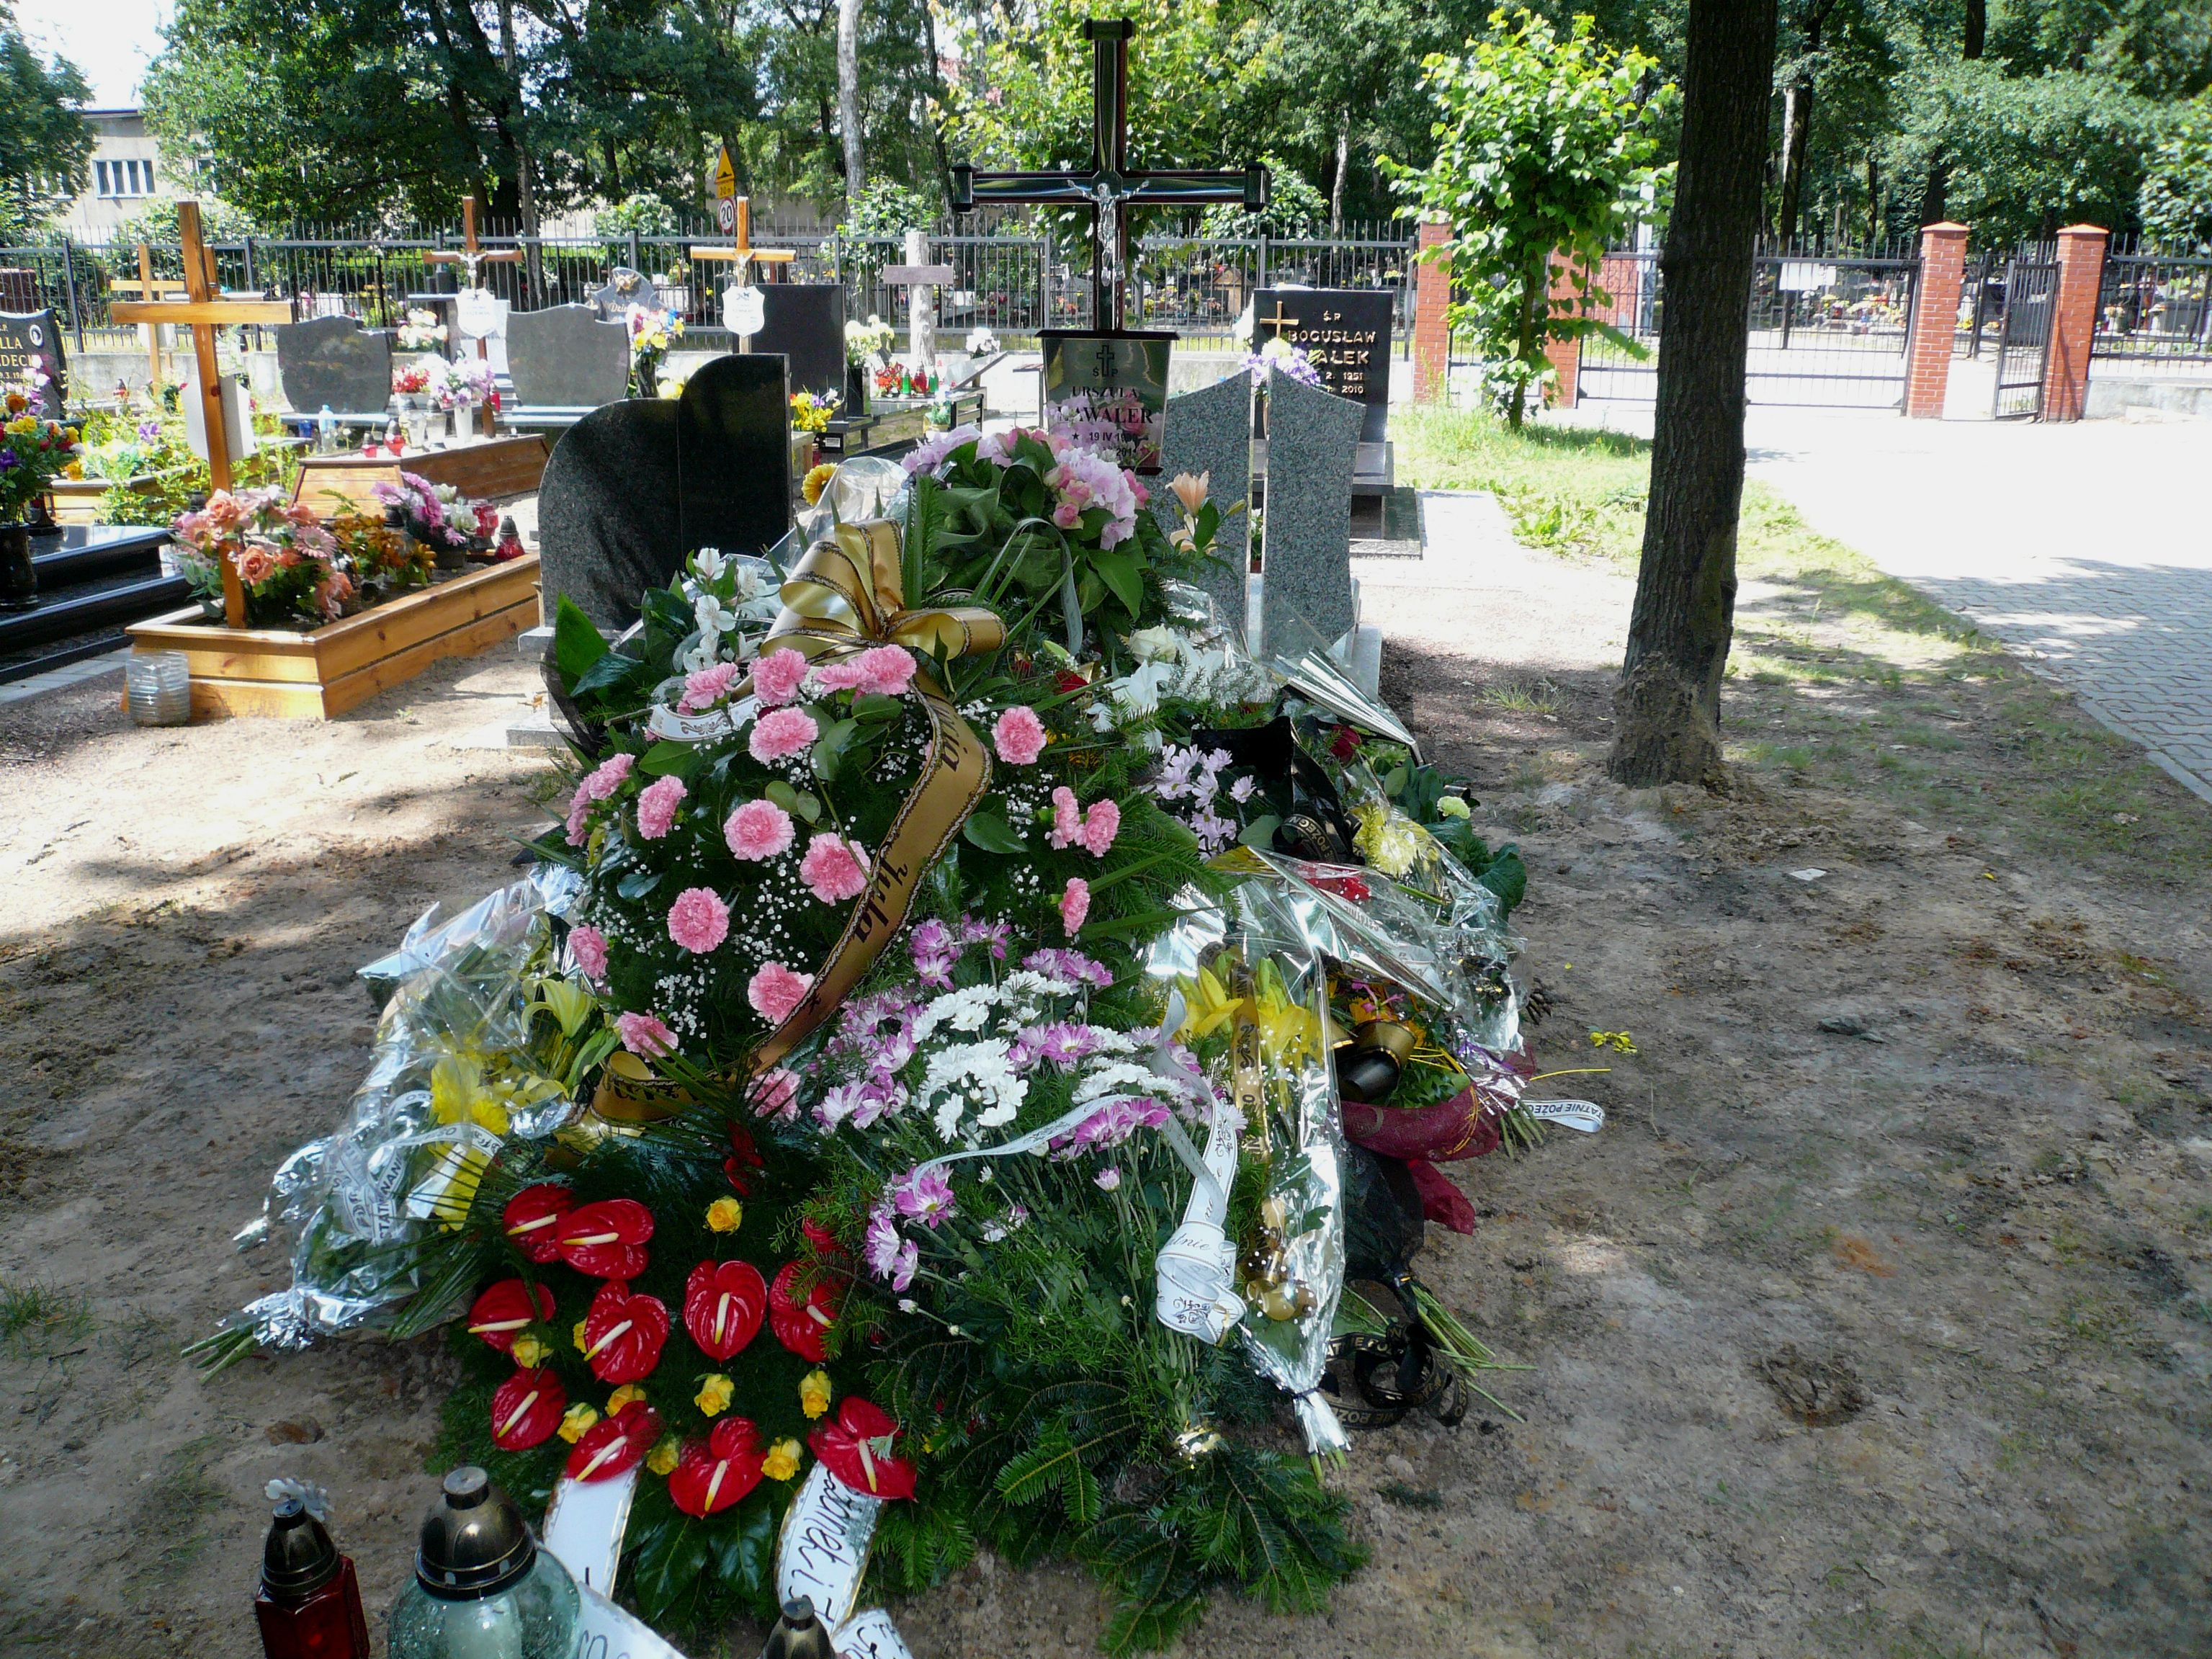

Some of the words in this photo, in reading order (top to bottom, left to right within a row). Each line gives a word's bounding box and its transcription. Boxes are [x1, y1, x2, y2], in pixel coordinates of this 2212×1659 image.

[721, 205, 733, 224] 20
[1288, 330, 1376, 343] BOGUSŁAW
[1317, 350, 1369, 365] AŁEK
[1343, 372, 1364, 381] 1951
[1073, 385, 1138, 398] URSZULA
[1342, 385, 1364, 394] 2010
[1057, 406, 1153, 424] AWALER
[1102, 432, 1112, 441] IV
[1565, 1103, 1605, 1119] TATNIE
